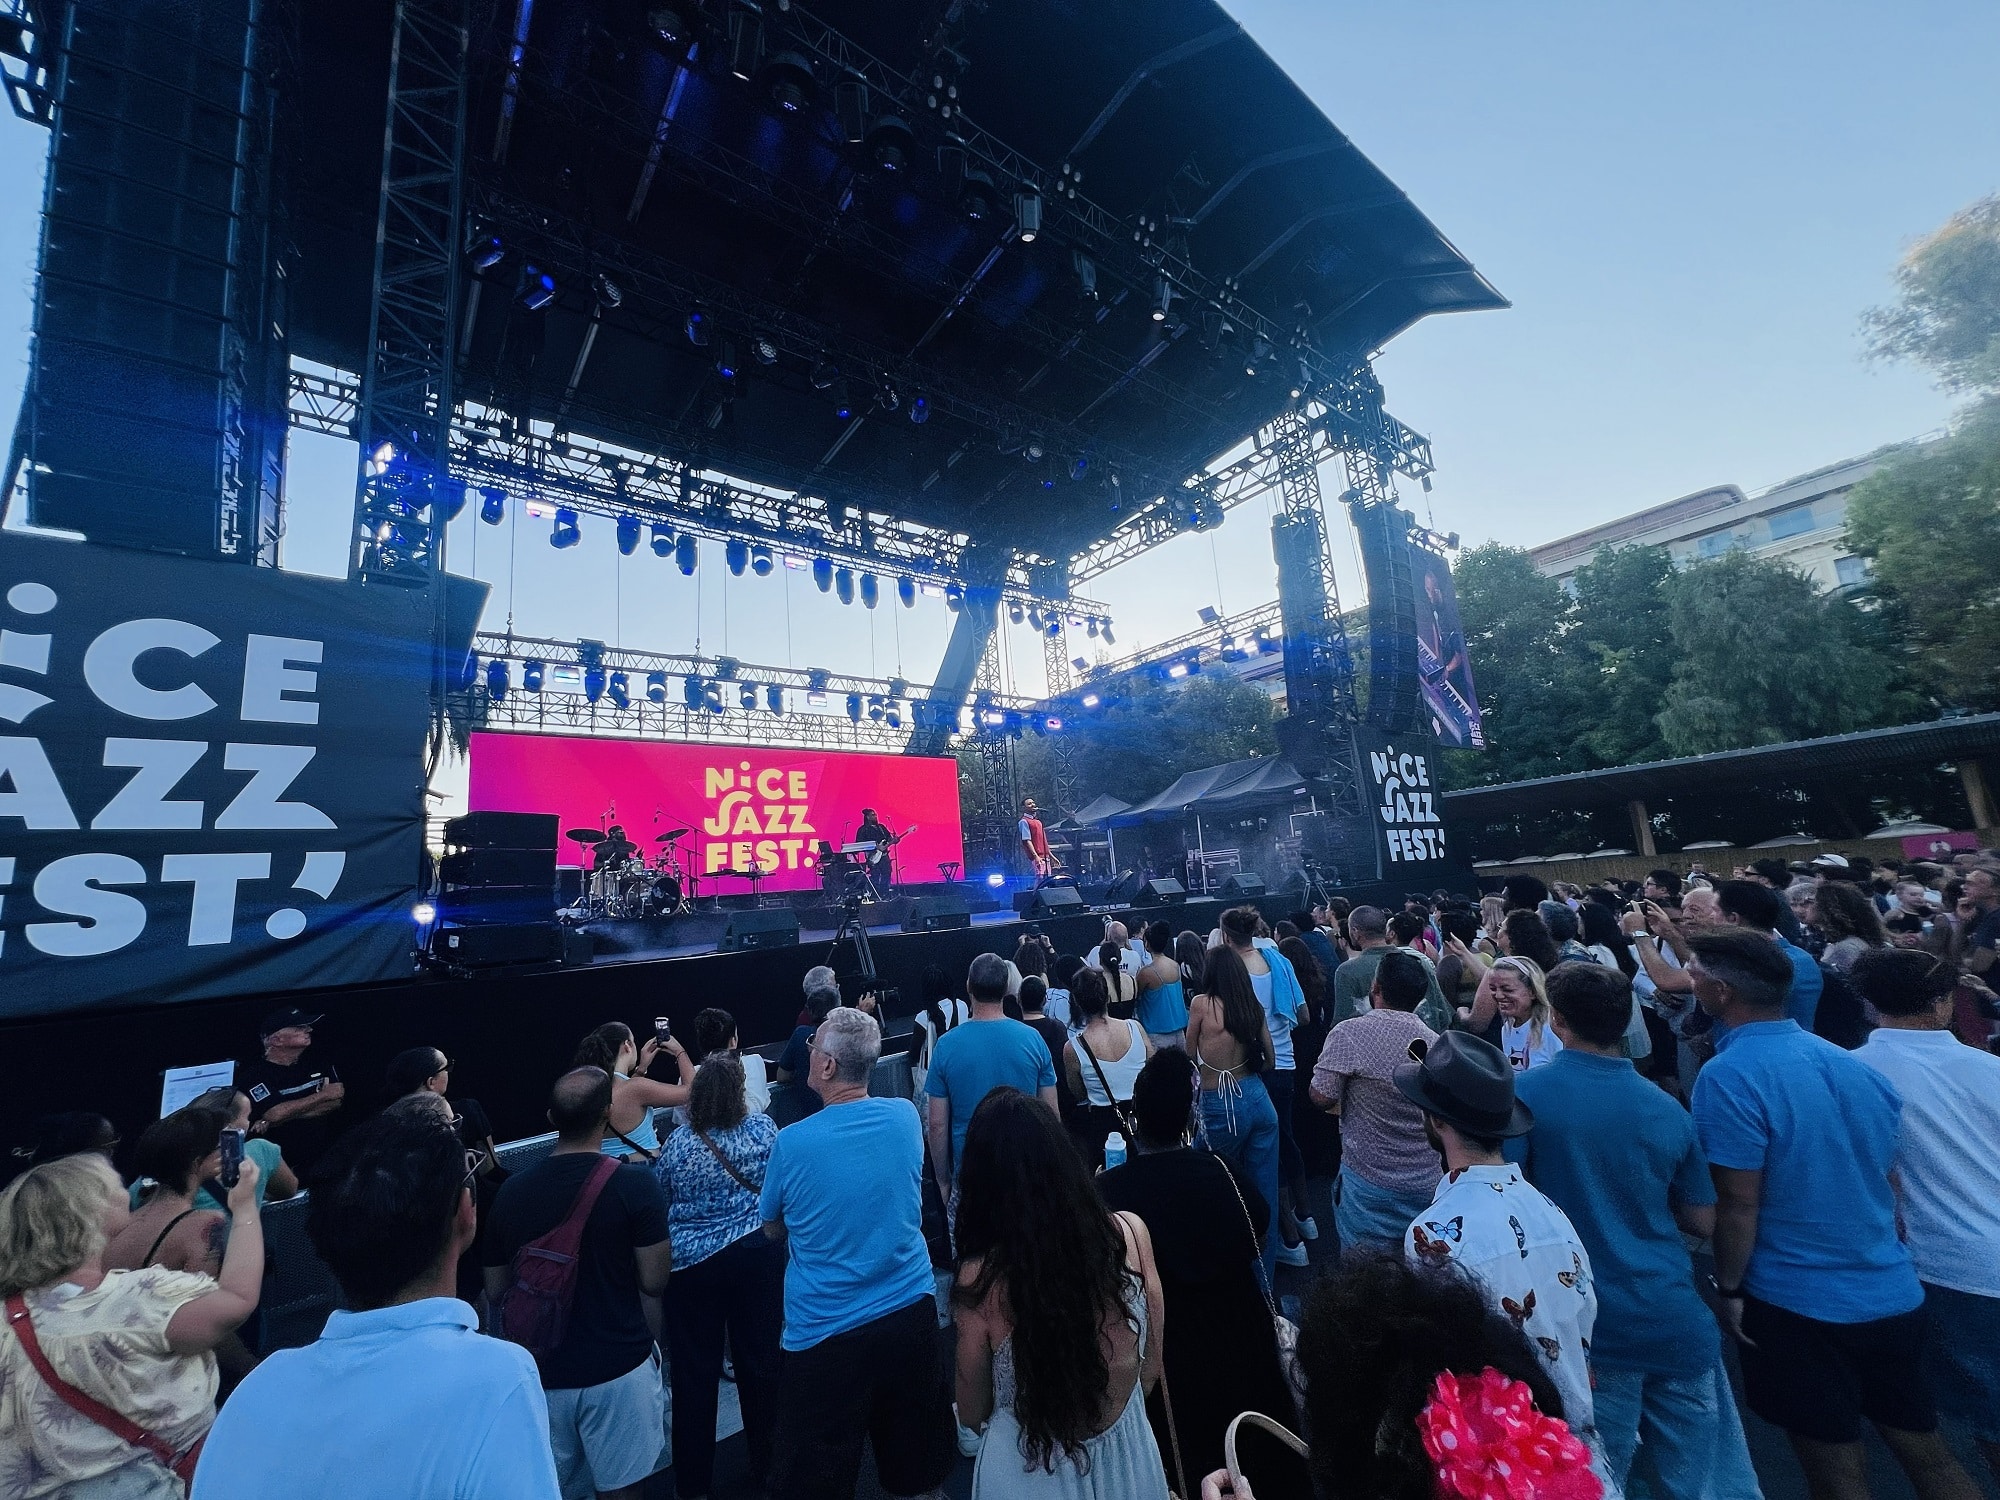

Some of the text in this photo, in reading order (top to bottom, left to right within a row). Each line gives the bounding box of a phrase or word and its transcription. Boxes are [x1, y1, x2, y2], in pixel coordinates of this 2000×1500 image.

[0, 582, 324, 725] iCE
[0, 683, 338, 830] AZZ
[704, 790, 817, 837] JAZZ
[1379, 776, 1441, 823] JAZZ
[706, 838, 820, 874] FEST!
[1386, 828, 1446, 862] FEST!
[0, 851, 346, 957] ST!
